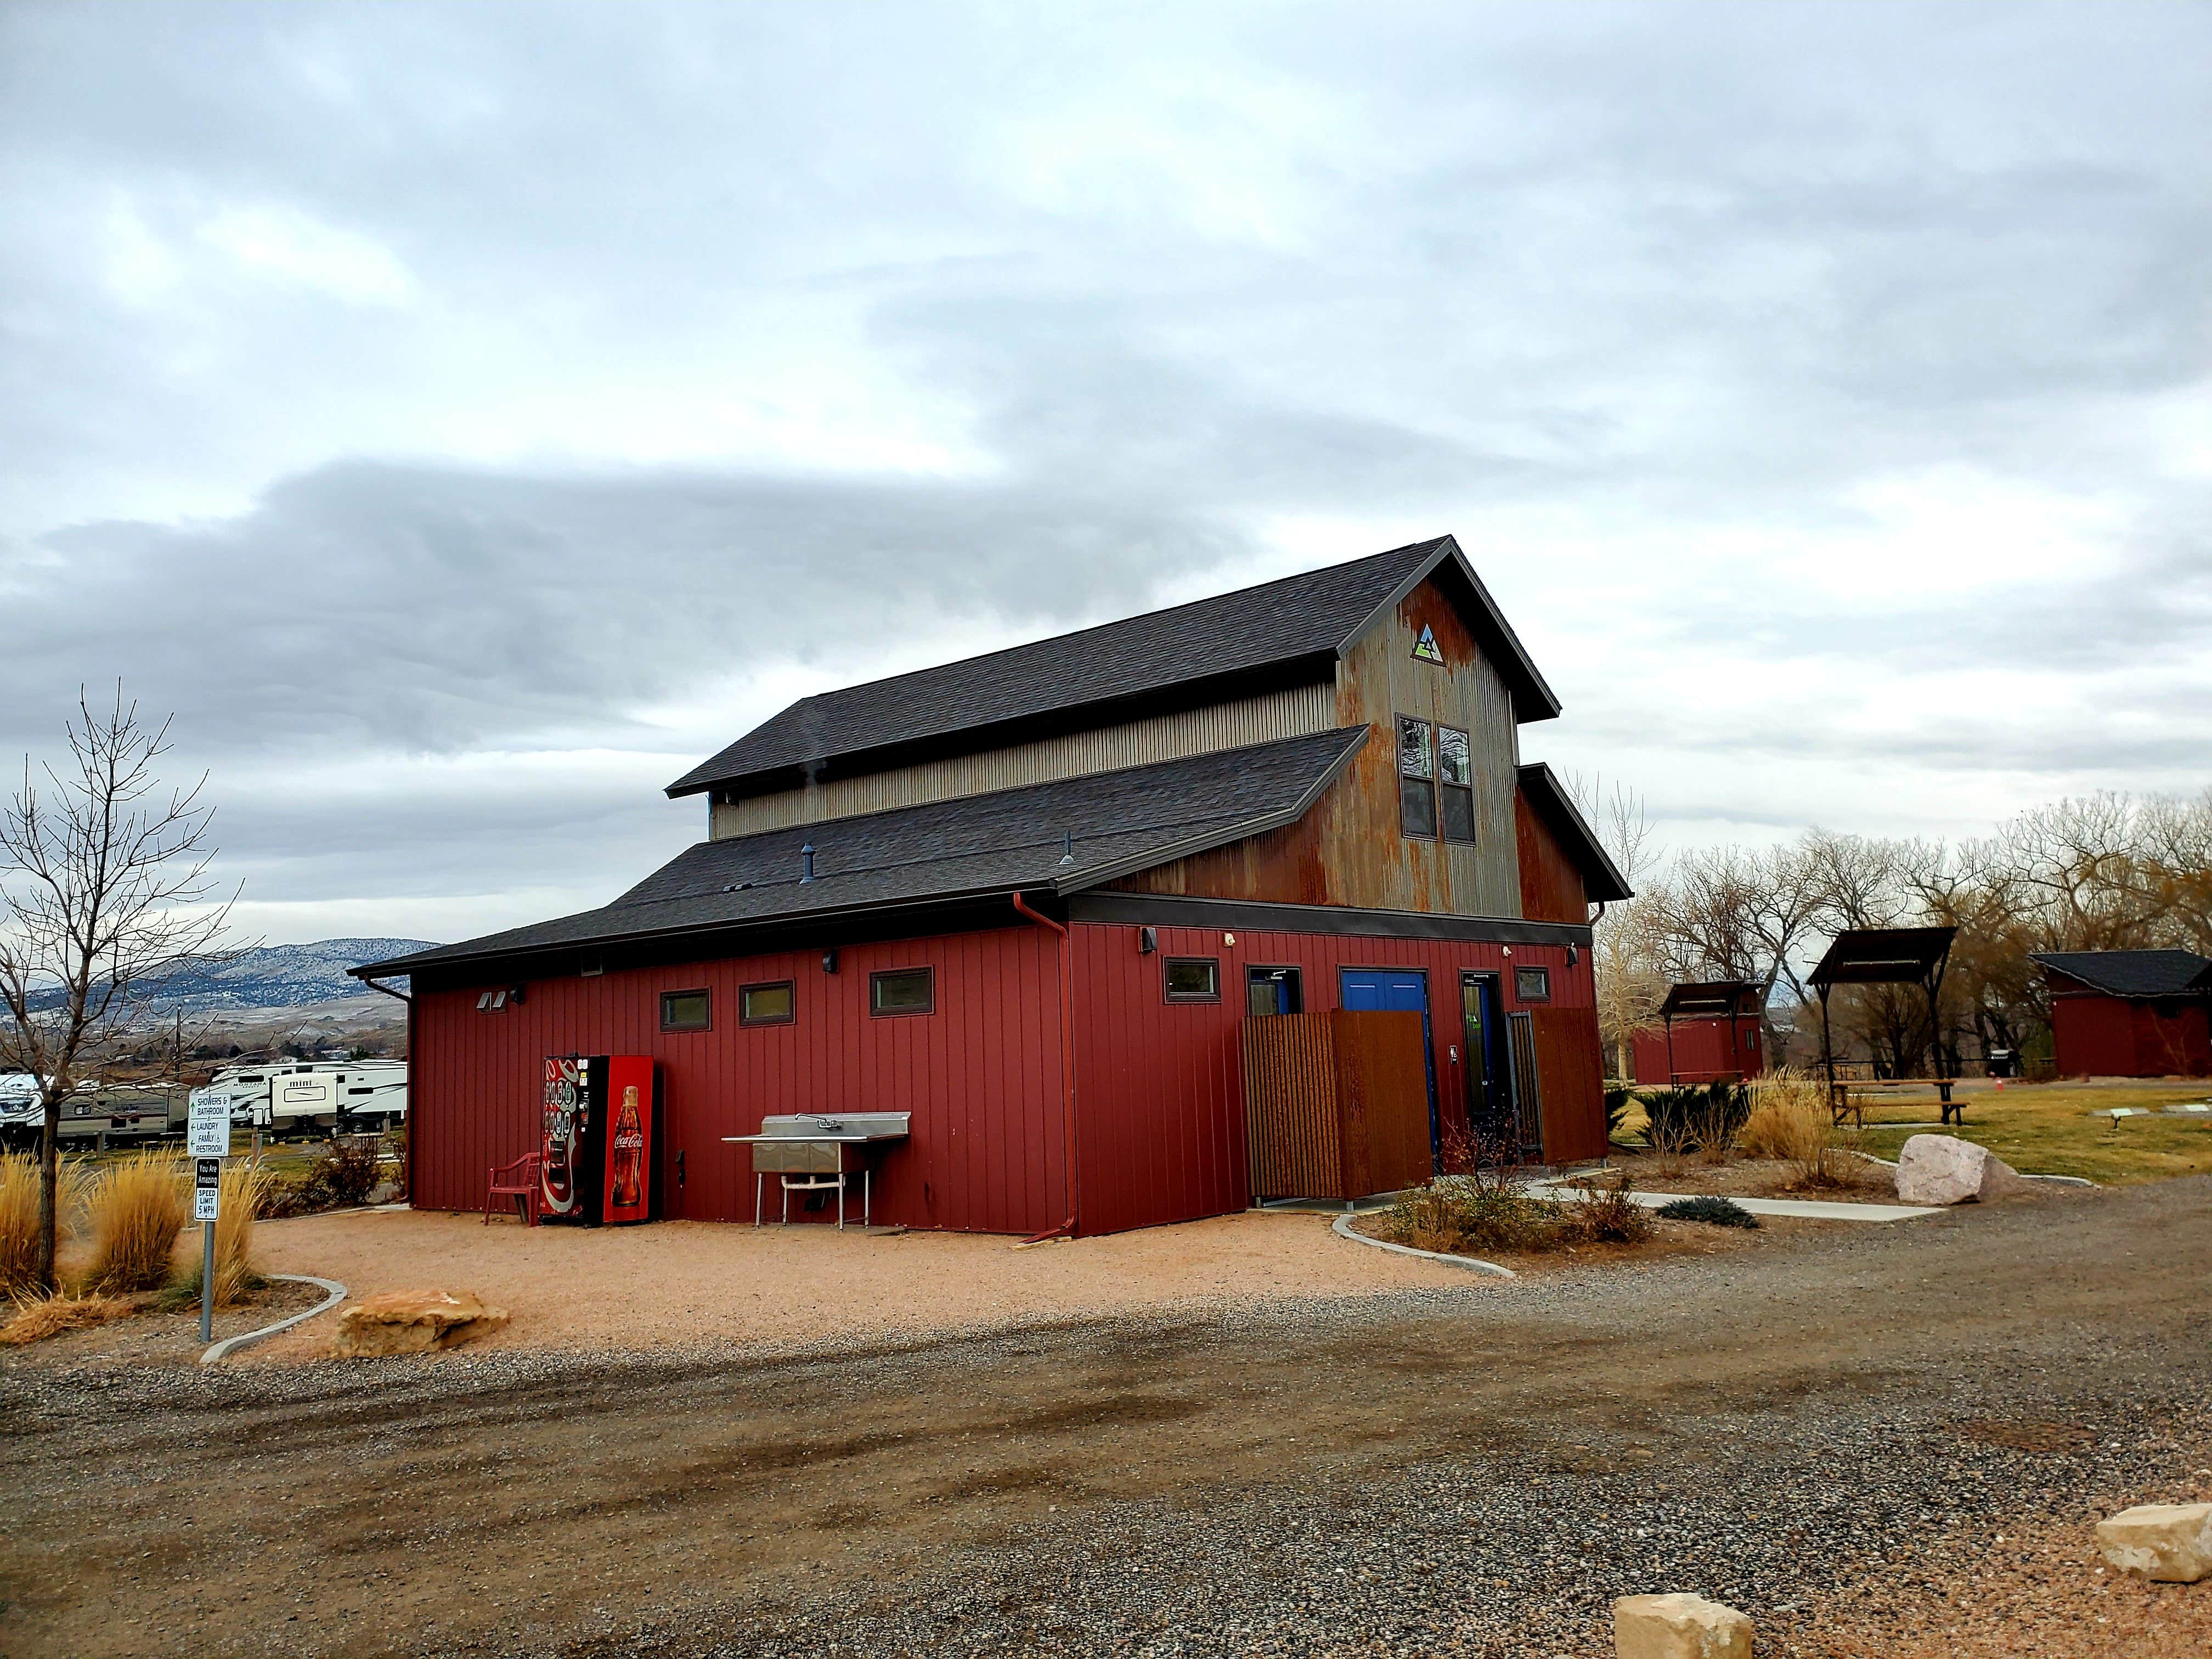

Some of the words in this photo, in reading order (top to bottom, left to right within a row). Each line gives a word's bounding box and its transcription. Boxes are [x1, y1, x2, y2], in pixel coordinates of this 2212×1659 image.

[290, 1079, 312, 1087] mini
[198, 1097, 222, 1106] SHOWERS
[198, 1107, 224, 1115] BATHROOM
[197, 1122, 219, 1130] LAUNDRY
[196, 1144, 223, 1153] RESTROOM
[199, 1164, 208, 1173] You
[208, 1164, 217, 1173] Are
[198, 1175, 217, 1186] Amazing
[199, 1205, 202, 1215] 5
[204, 1205, 215, 1215] MPH
